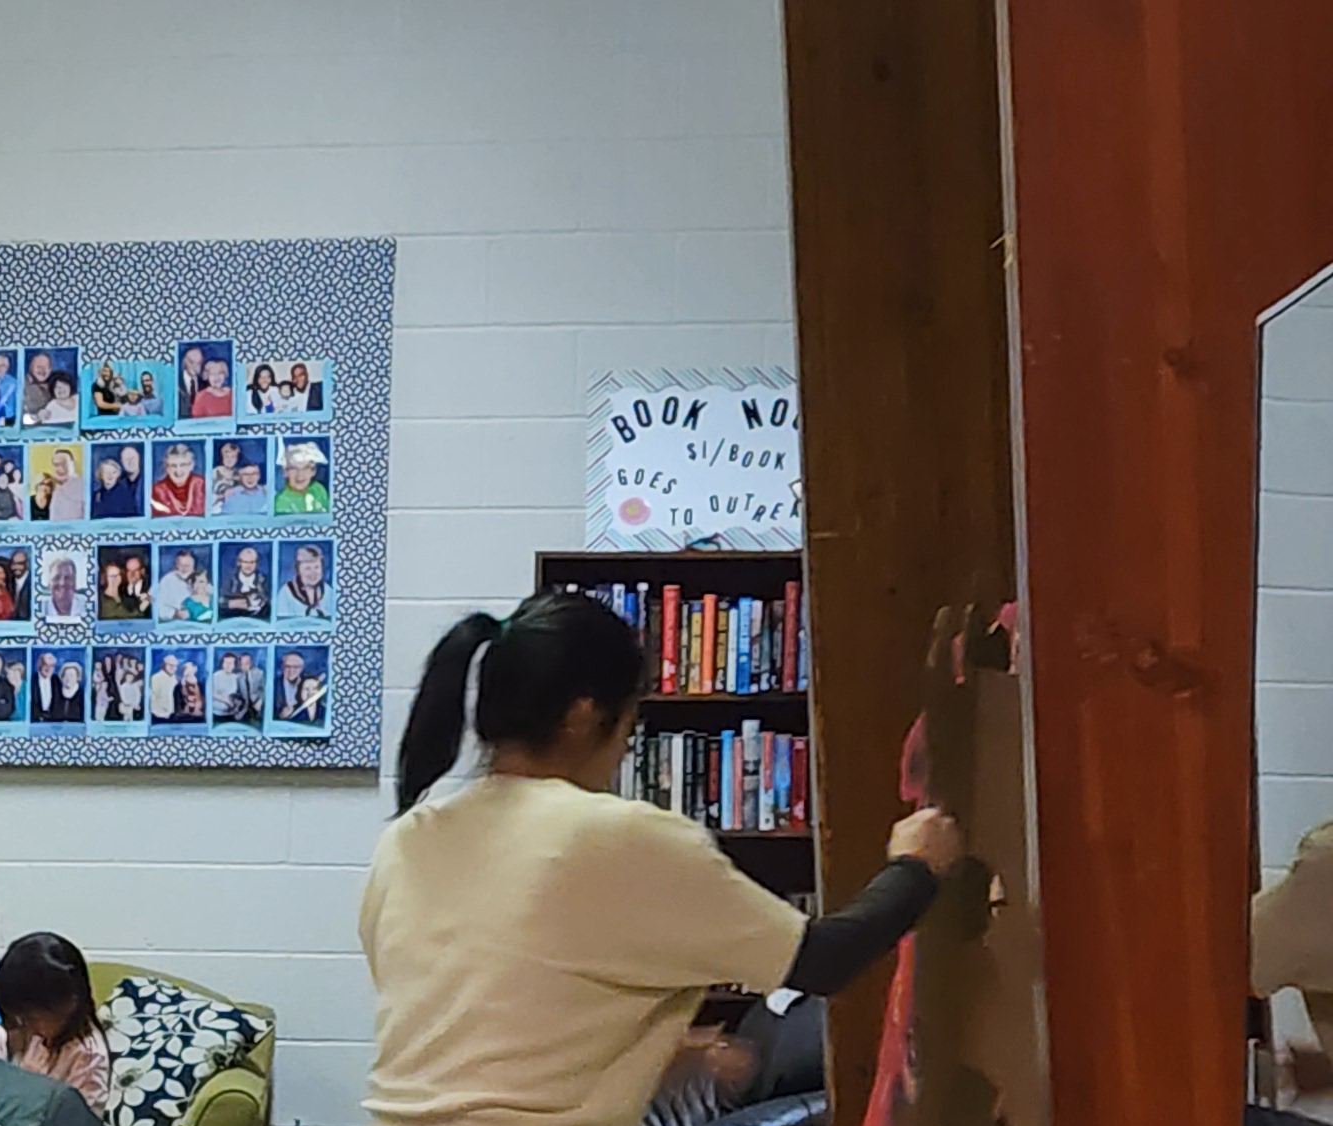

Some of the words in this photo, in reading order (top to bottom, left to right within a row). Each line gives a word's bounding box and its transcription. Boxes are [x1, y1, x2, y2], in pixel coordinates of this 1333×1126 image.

[611, 396, 708, 443] BOOK
[617, 468, 678, 494] GOES
[669, 507, 693, 526] TO
